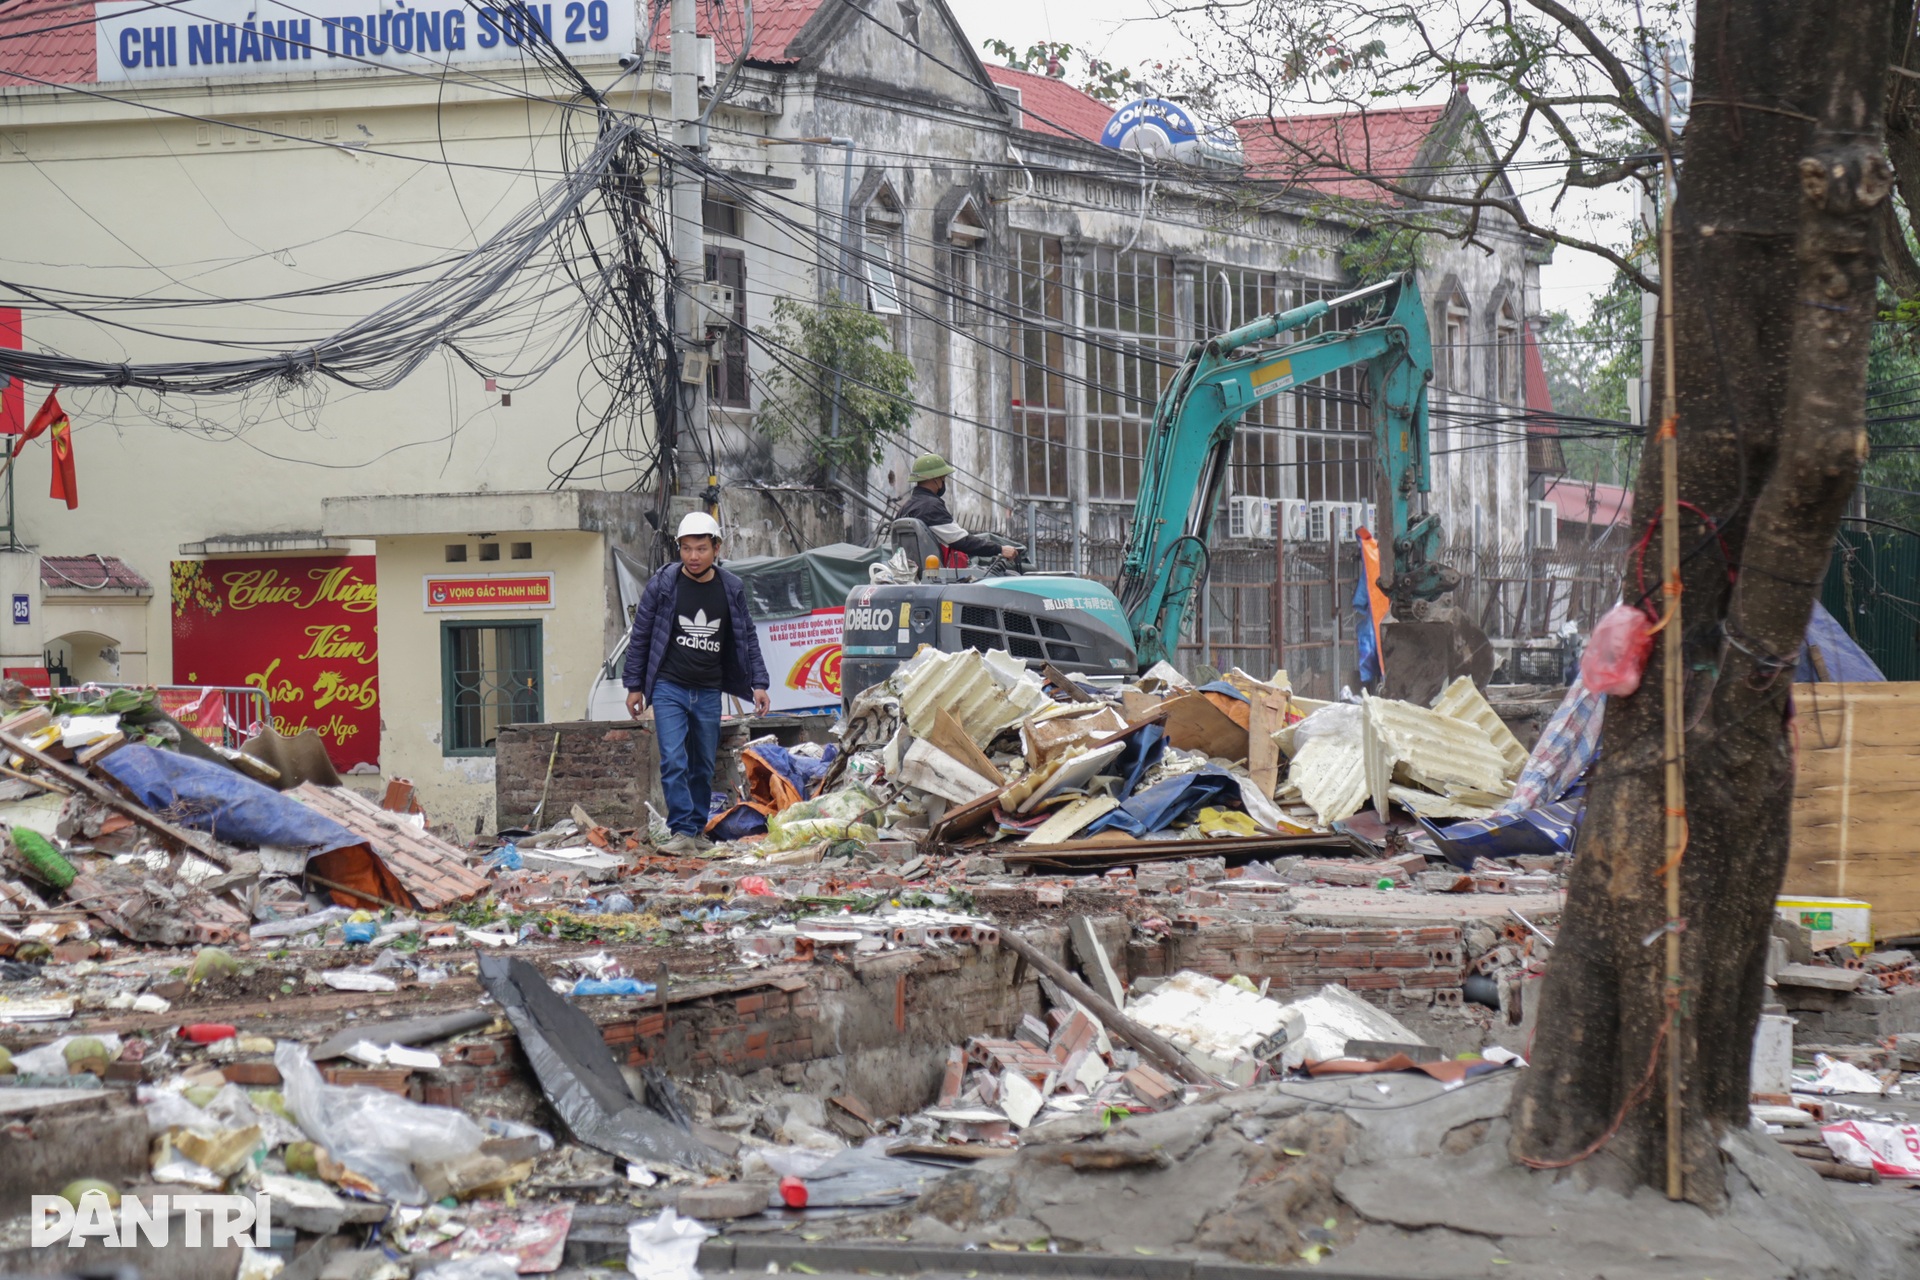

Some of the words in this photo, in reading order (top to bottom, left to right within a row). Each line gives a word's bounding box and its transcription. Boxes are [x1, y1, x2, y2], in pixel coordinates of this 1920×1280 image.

[120, 26, 178, 68] CHI
[188, 12, 312, 66] NHÁNH
[321, 0, 466, 57] TRƯỜNG
[477, 3, 552, 49] SƠN
[565, 1, 609, 43] 29
[222, 569, 302, 611] Chúc
[293, 567, 378, 613] Mừng
[449, 587, 475, 600] VỌNG
[476, 585, 496, 598] GÁC
[497, 586, 525, 597] THANH
[527, 583, 546, 596] NIÊN
[15, 601, 28, 617] 25
[298, 625, 366, 660] Năm
[676, 635, 720, 652] adidas
[245, 658, 304, 720] Xuân
[313, 670, 378, 710] 2026
[317, 714, 359, 746] Ngọ
